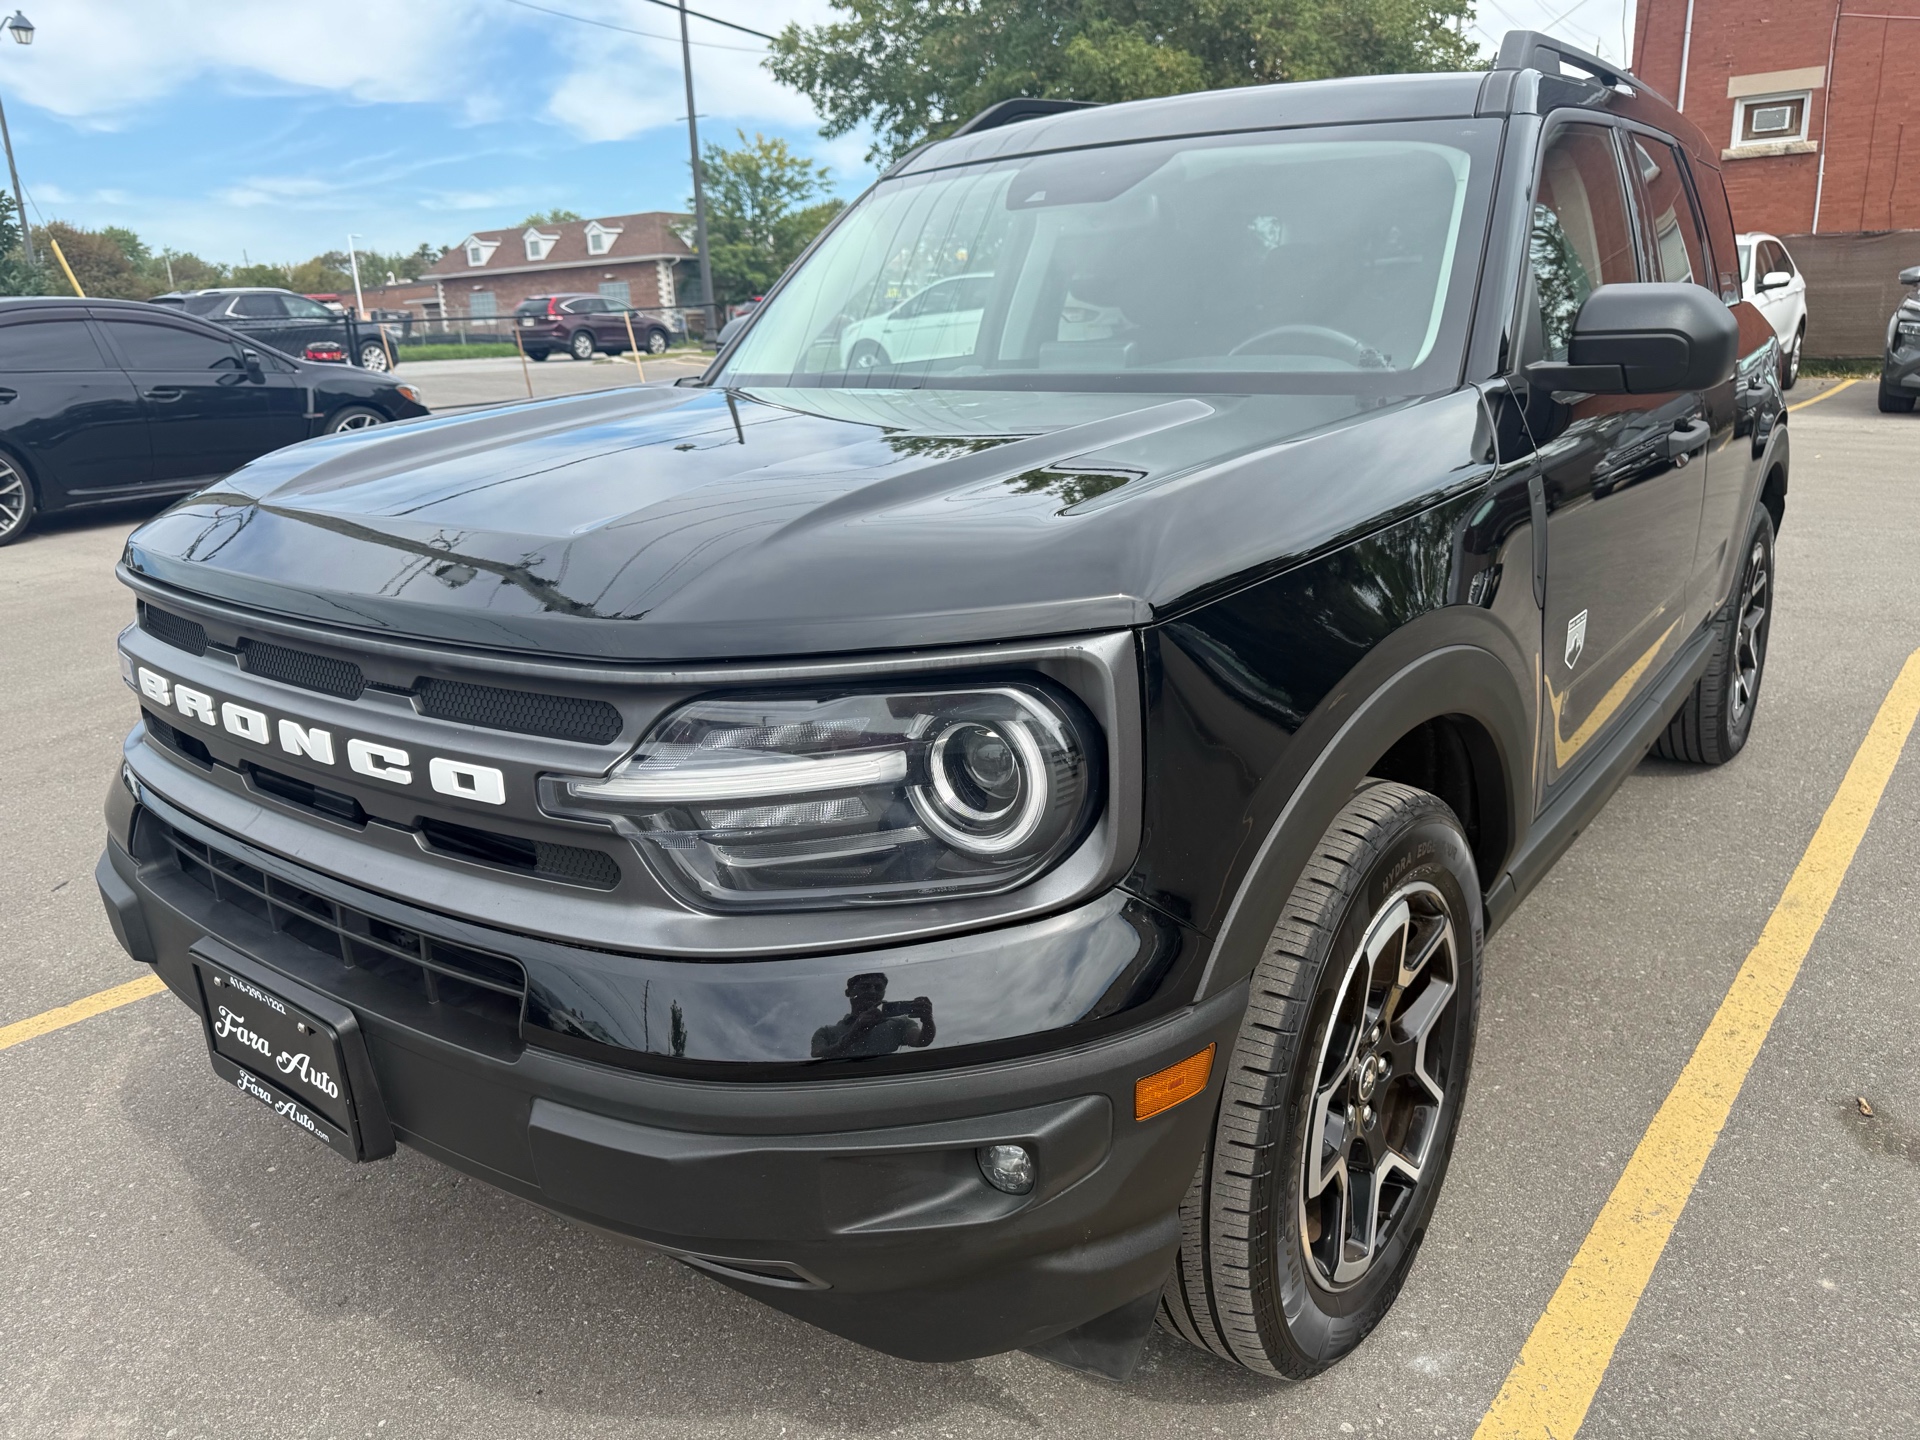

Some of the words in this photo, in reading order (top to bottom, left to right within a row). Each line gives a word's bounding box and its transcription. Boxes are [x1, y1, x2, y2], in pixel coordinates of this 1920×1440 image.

[138, 667, 506, 805] BRONCO
[1383, 852, 1412, 894] HYDRA
[230, 976, 287, 1016] 416-299-1222
[215, 1005, 272, 1057] Fara
[276, 1051, 339, 1099] Auto
[237, 1069, 273, 1105] Fara
